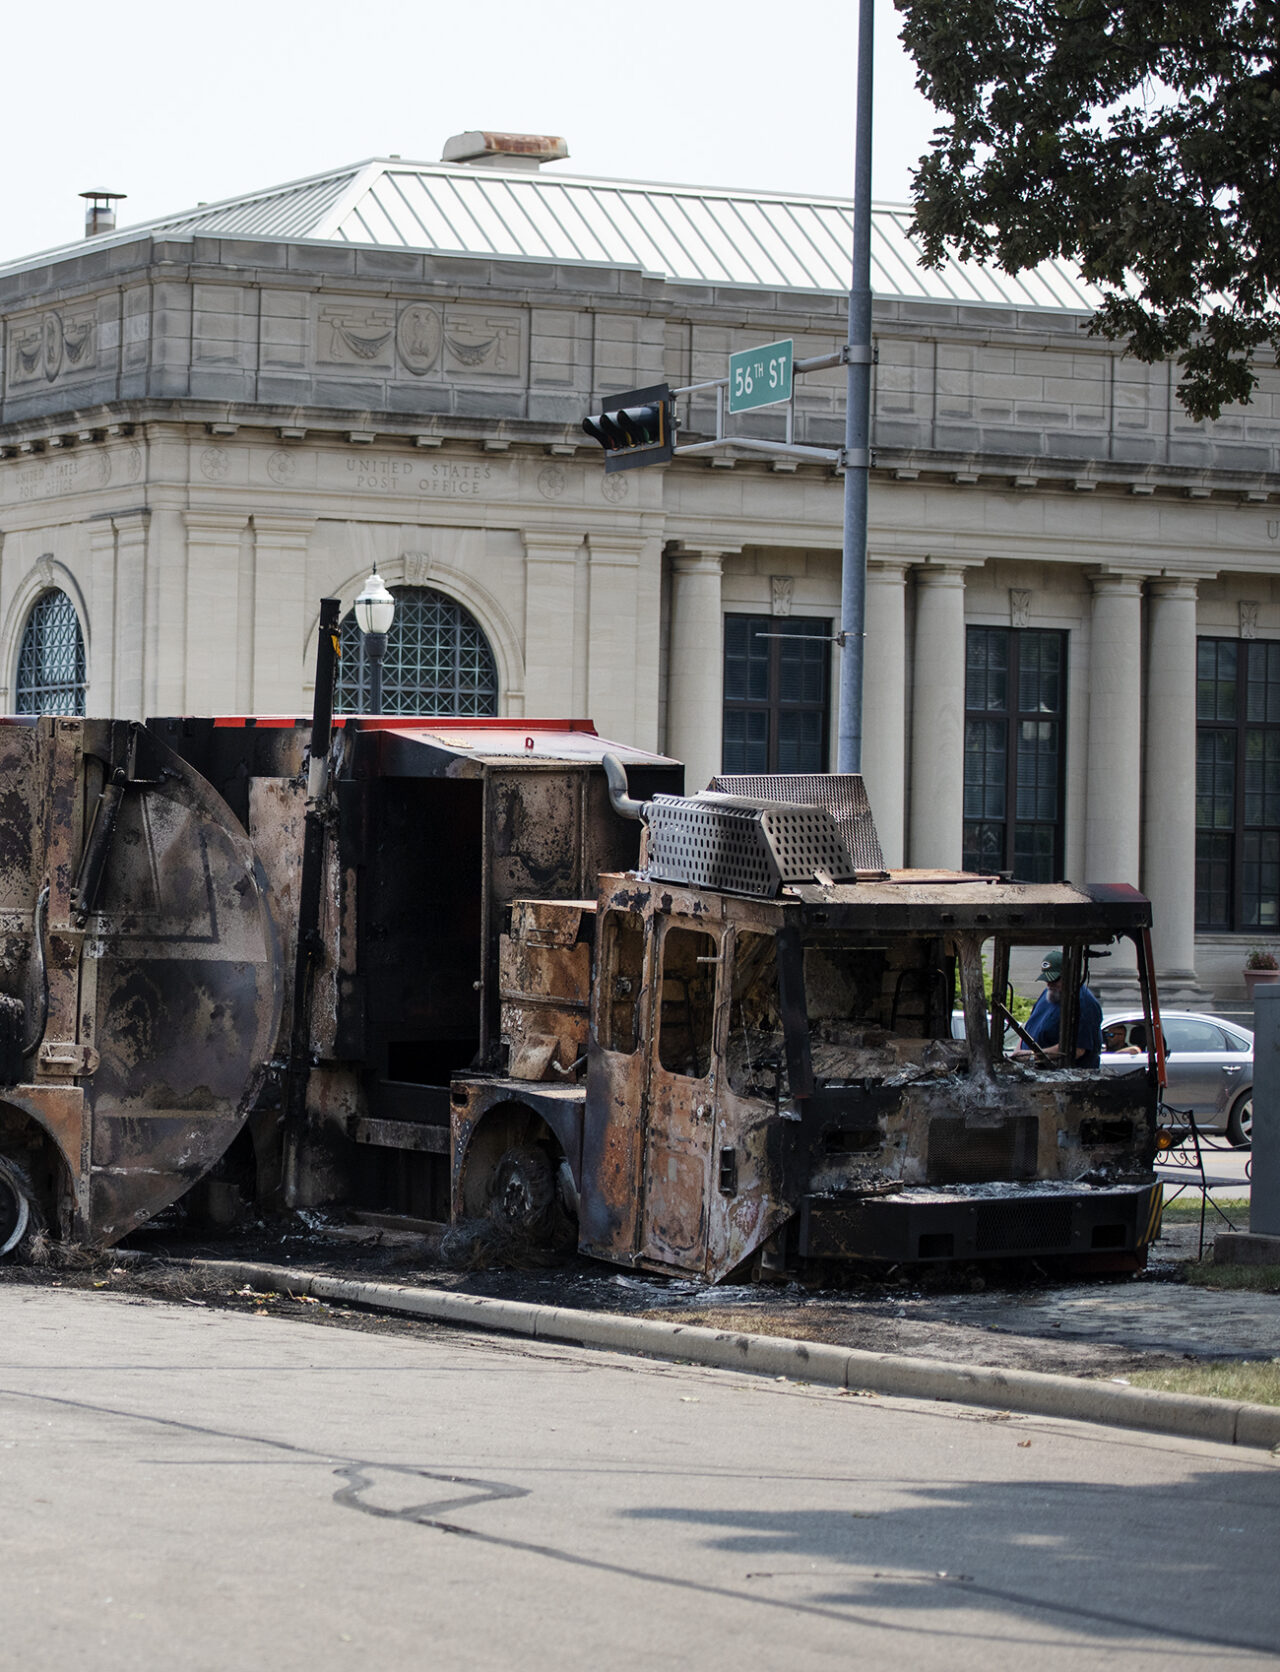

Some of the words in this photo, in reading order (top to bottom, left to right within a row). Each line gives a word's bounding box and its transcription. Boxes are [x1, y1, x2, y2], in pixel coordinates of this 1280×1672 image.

[735, 362, 764, 397] 56TH
[769, 356, 786, 389] ST
[346, 459, 413, 474] UNITED
[432, 464, 490, 479] STATES
[357, 476, 399, 489] POST
[419, 479, 480, 494] OFFICE
